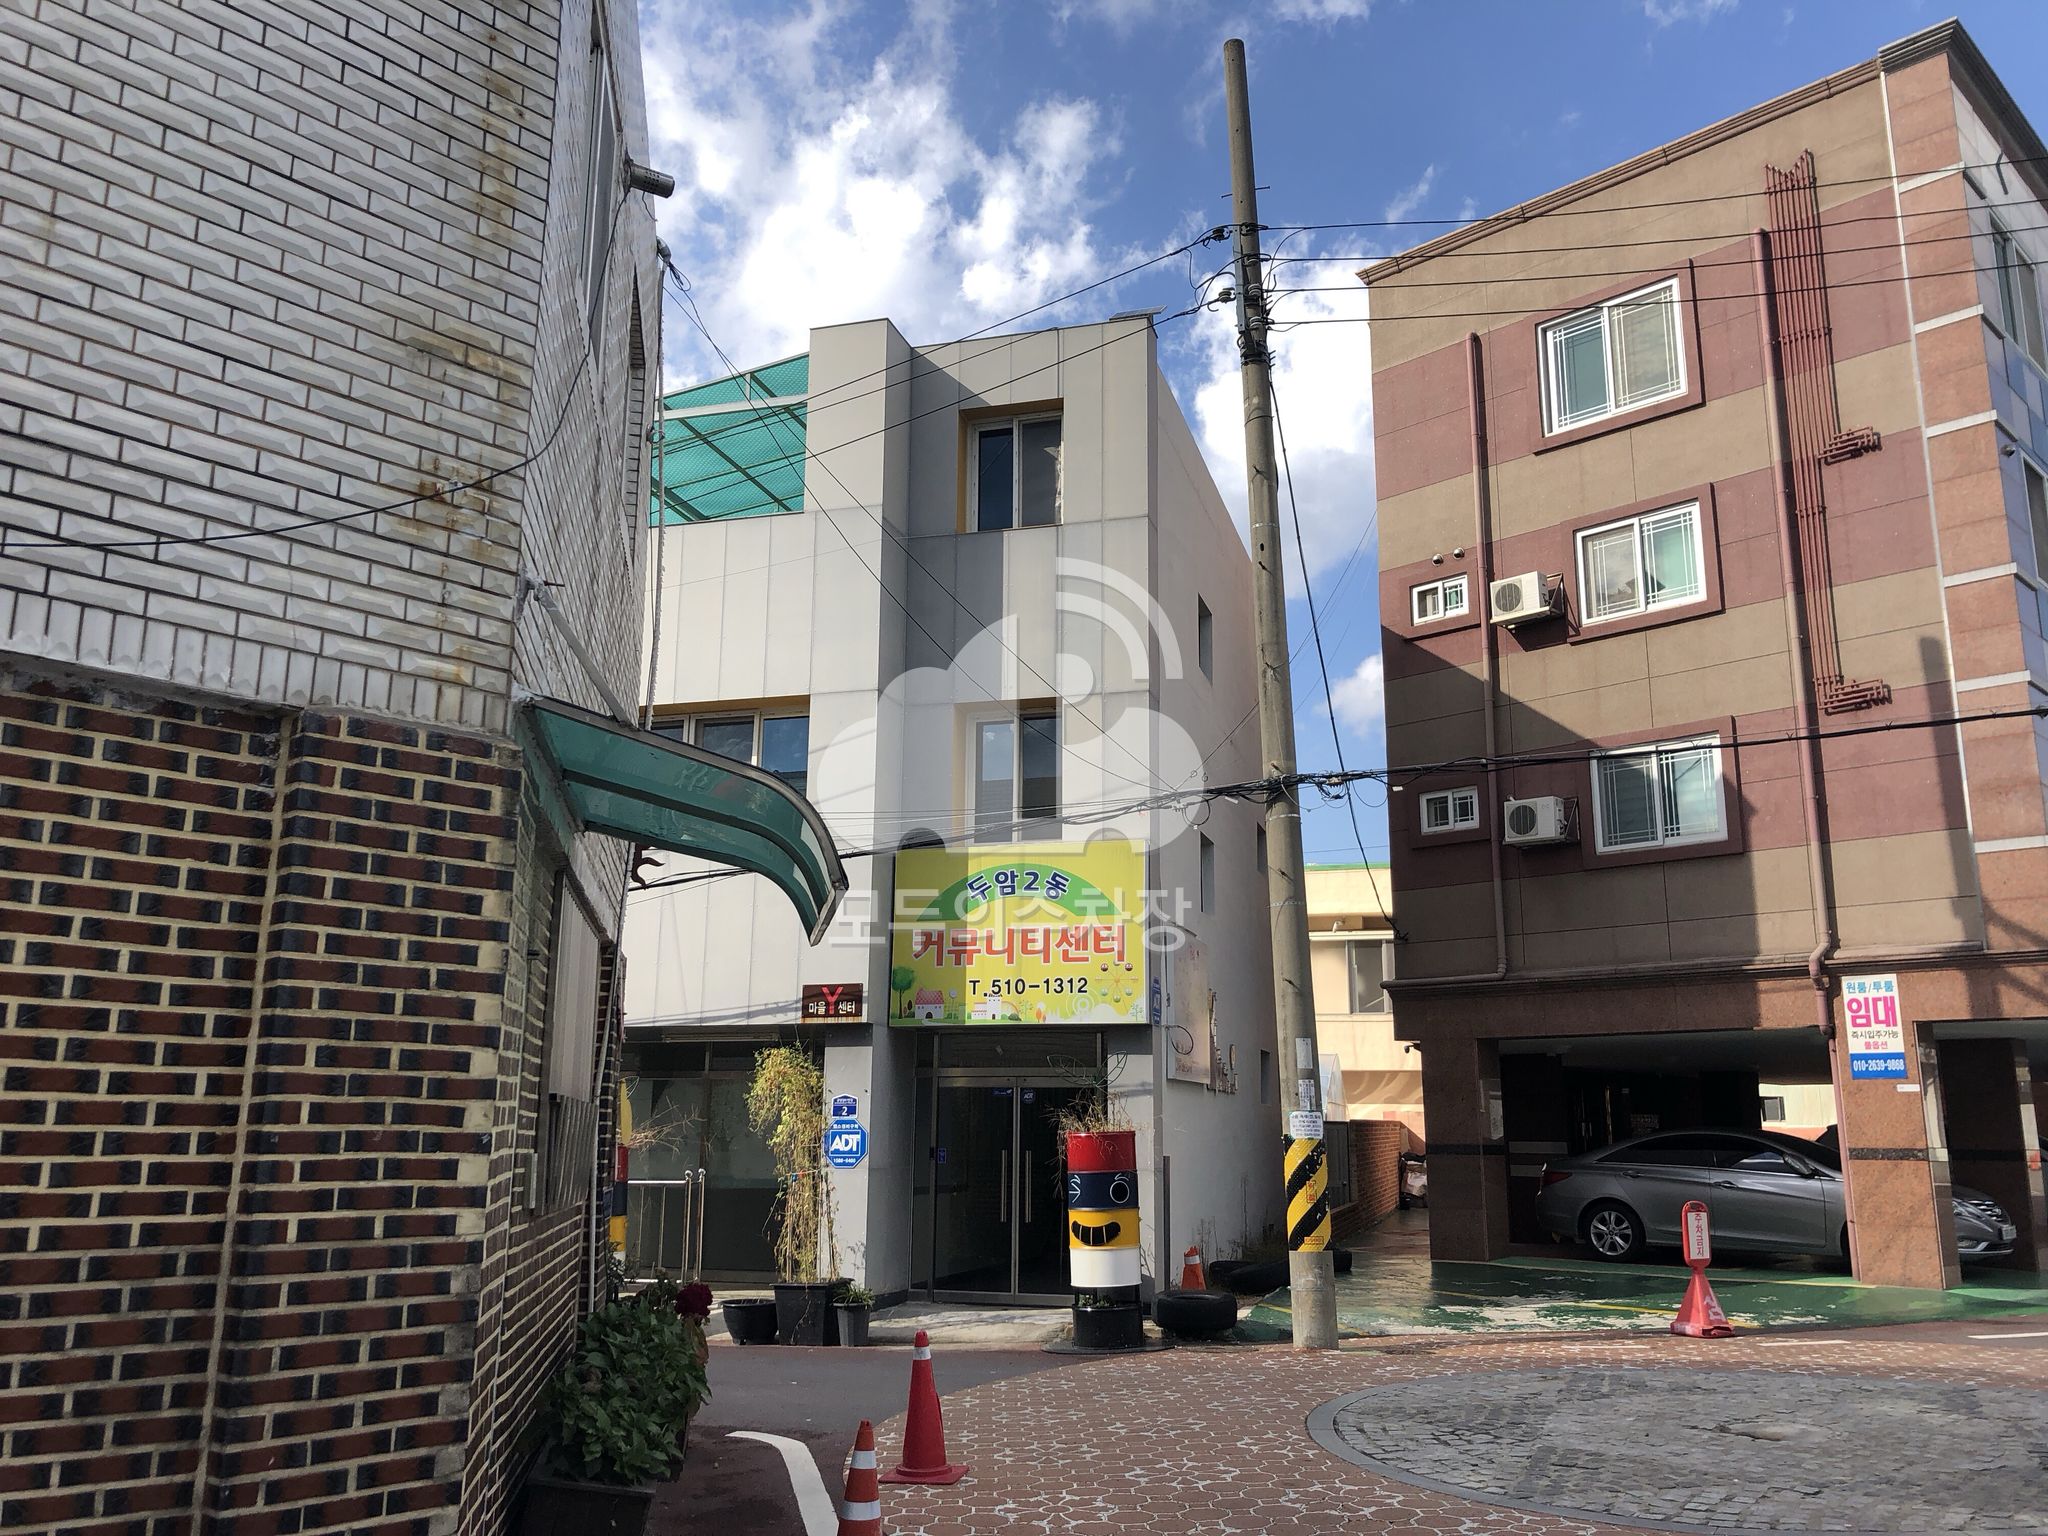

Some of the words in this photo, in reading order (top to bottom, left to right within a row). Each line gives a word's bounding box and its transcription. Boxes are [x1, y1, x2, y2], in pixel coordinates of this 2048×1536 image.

[965, 869, 1071, 902] 두암2동
[911, 924, 1126, 968] 커뮤니티센터
[808, 1001, 827, 1015] 마을
[838, 1000, 856, 1014] 센터
[1846, 995, 1898, 1028] 임대
[1851, 1029, 1899, 1039] 즉시입주가능
[841, 1106, 848, 1116] 2
[830, 1134, 860, 1152] ADT
[1694, 1213, 1705, 1257] 주차금지
